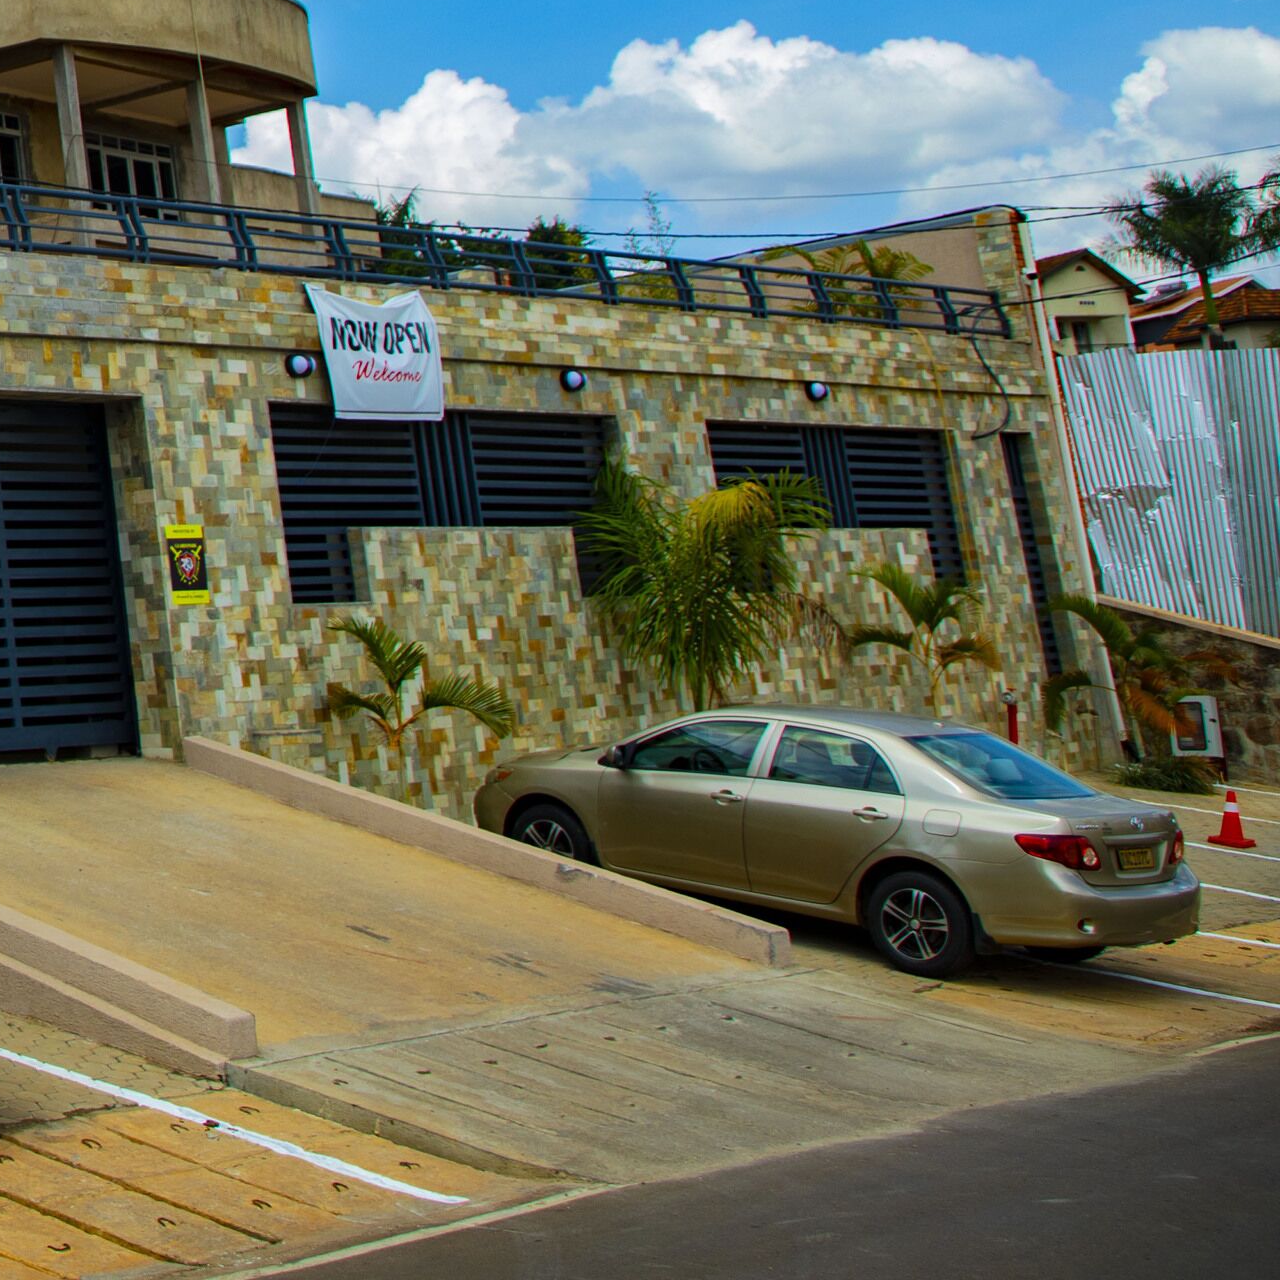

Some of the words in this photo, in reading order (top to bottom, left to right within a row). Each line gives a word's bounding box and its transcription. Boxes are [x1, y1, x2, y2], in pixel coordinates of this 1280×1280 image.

[330, 317, 378, 354] NOW
[383, 321, 432, 355] OPEN
[351, 357, 423, 383] Welcome
